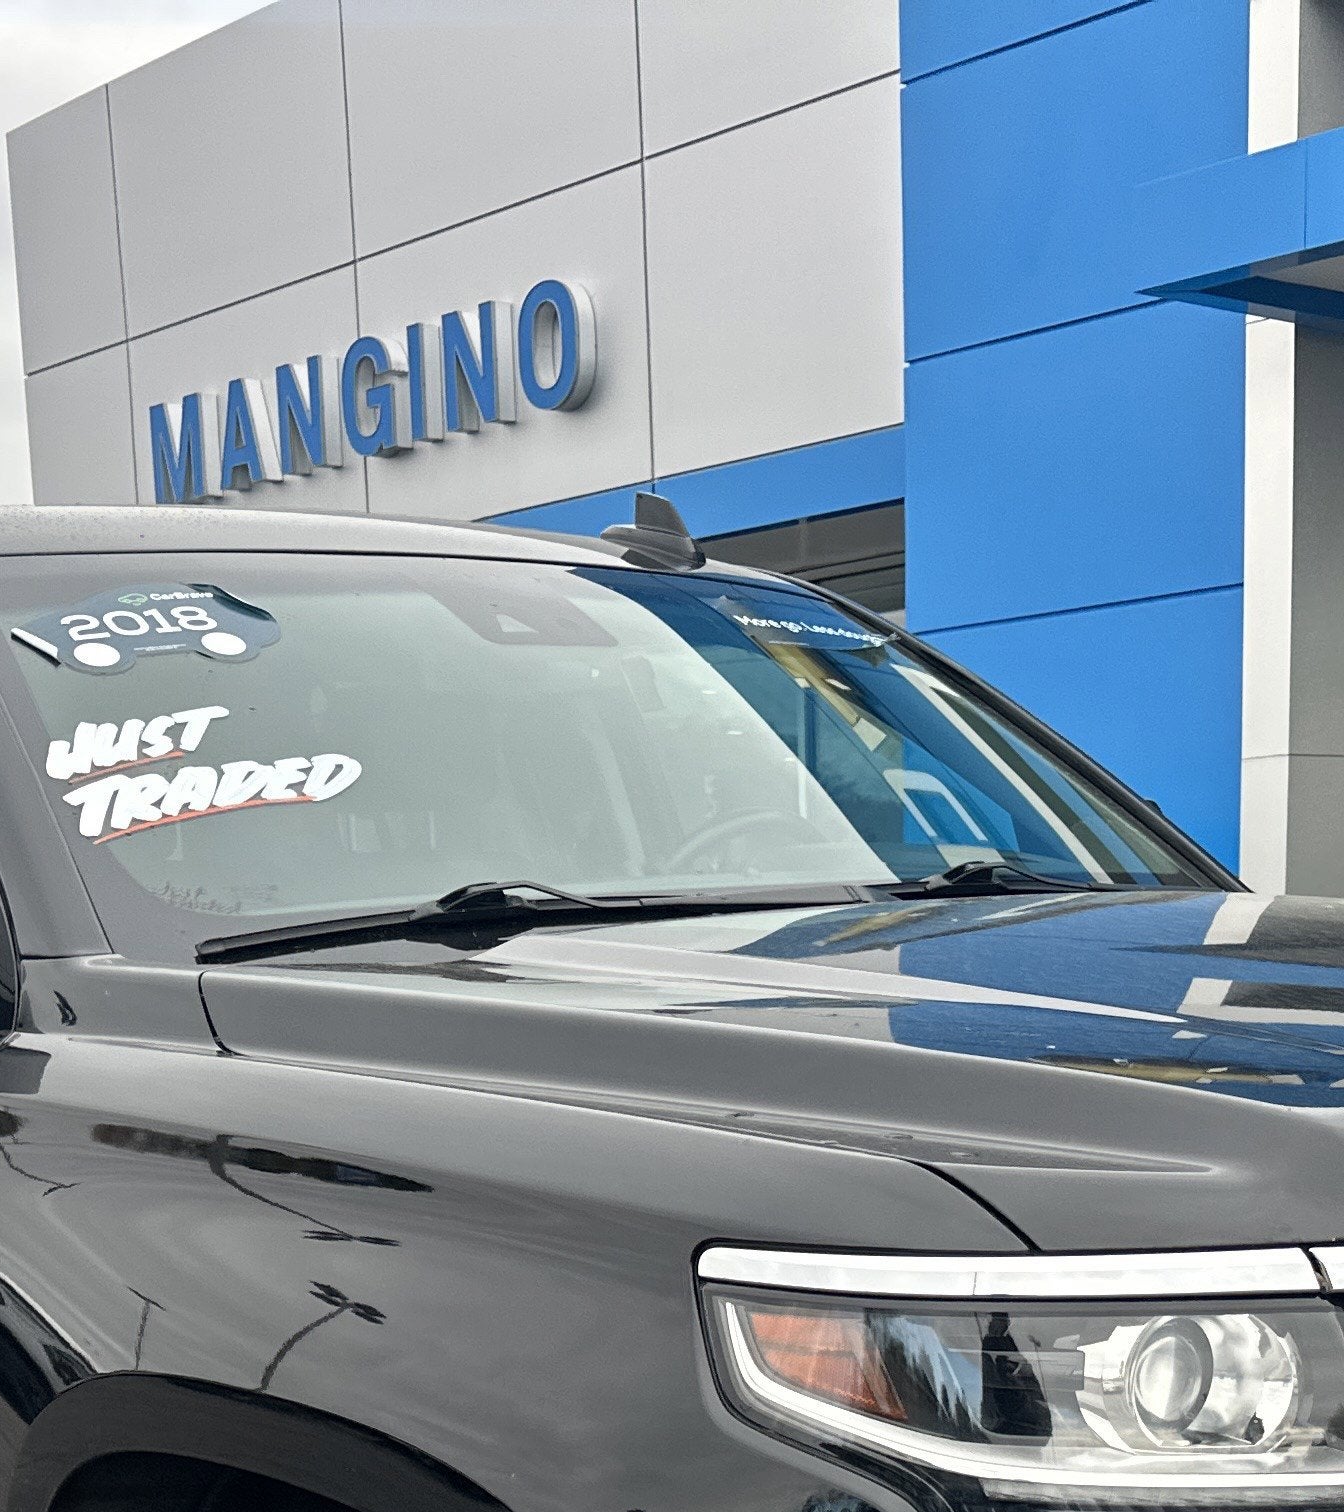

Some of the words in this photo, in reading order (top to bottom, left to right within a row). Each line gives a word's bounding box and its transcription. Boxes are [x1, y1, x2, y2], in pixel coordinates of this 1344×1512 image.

[150, 279, 597, 504] MANGINO
[61, 606, 218, 642] 2018
[45, 705, 230, 780] JUST
[62, 753, 362, 837] TRADED
